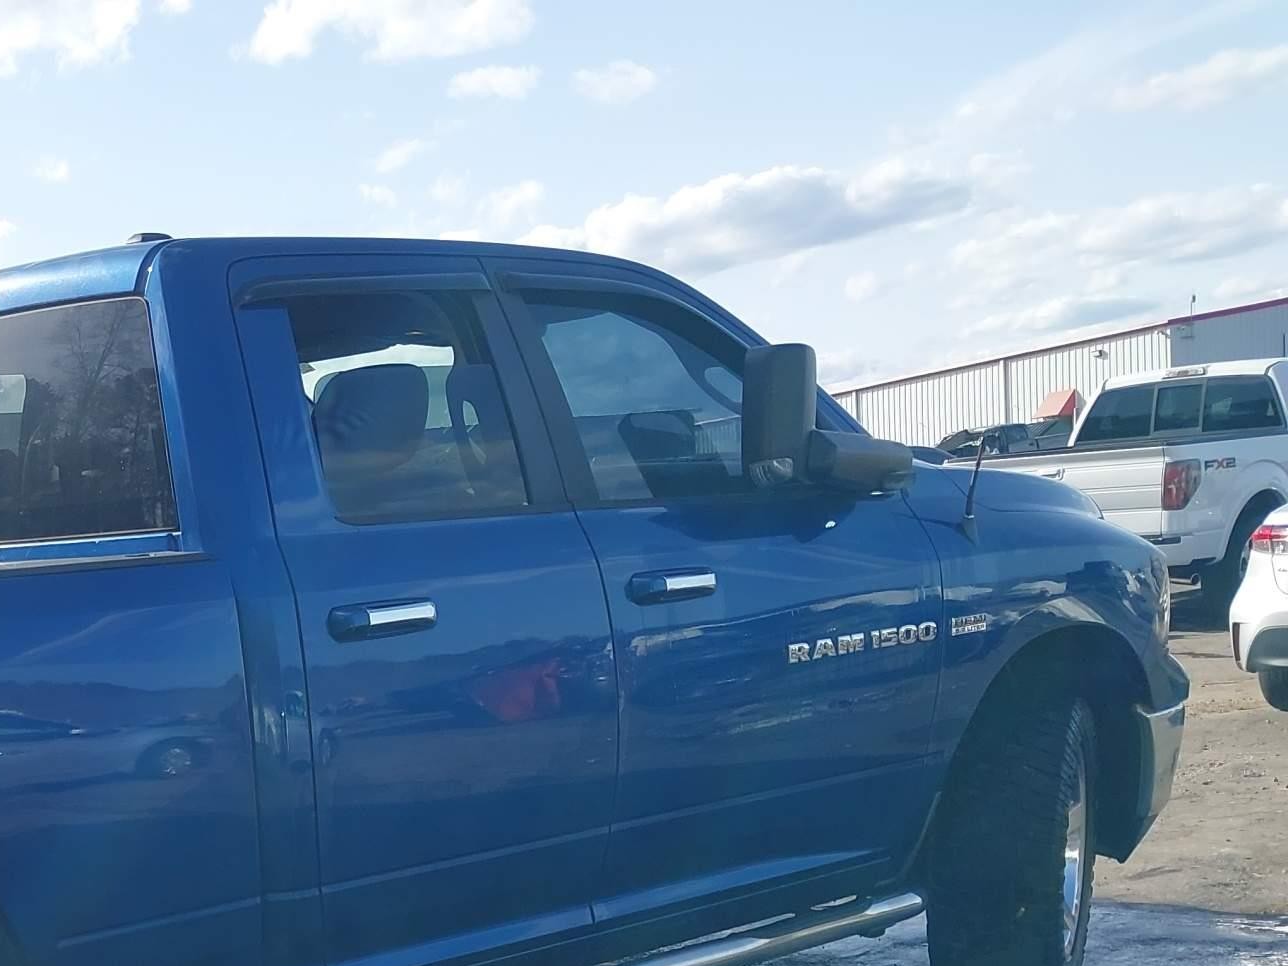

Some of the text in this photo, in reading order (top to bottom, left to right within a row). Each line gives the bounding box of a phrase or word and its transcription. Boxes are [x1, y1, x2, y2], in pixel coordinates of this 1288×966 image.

[1204, 457, 1237, 471] FX2
[788, 621, 938, 664] RAM 1500
